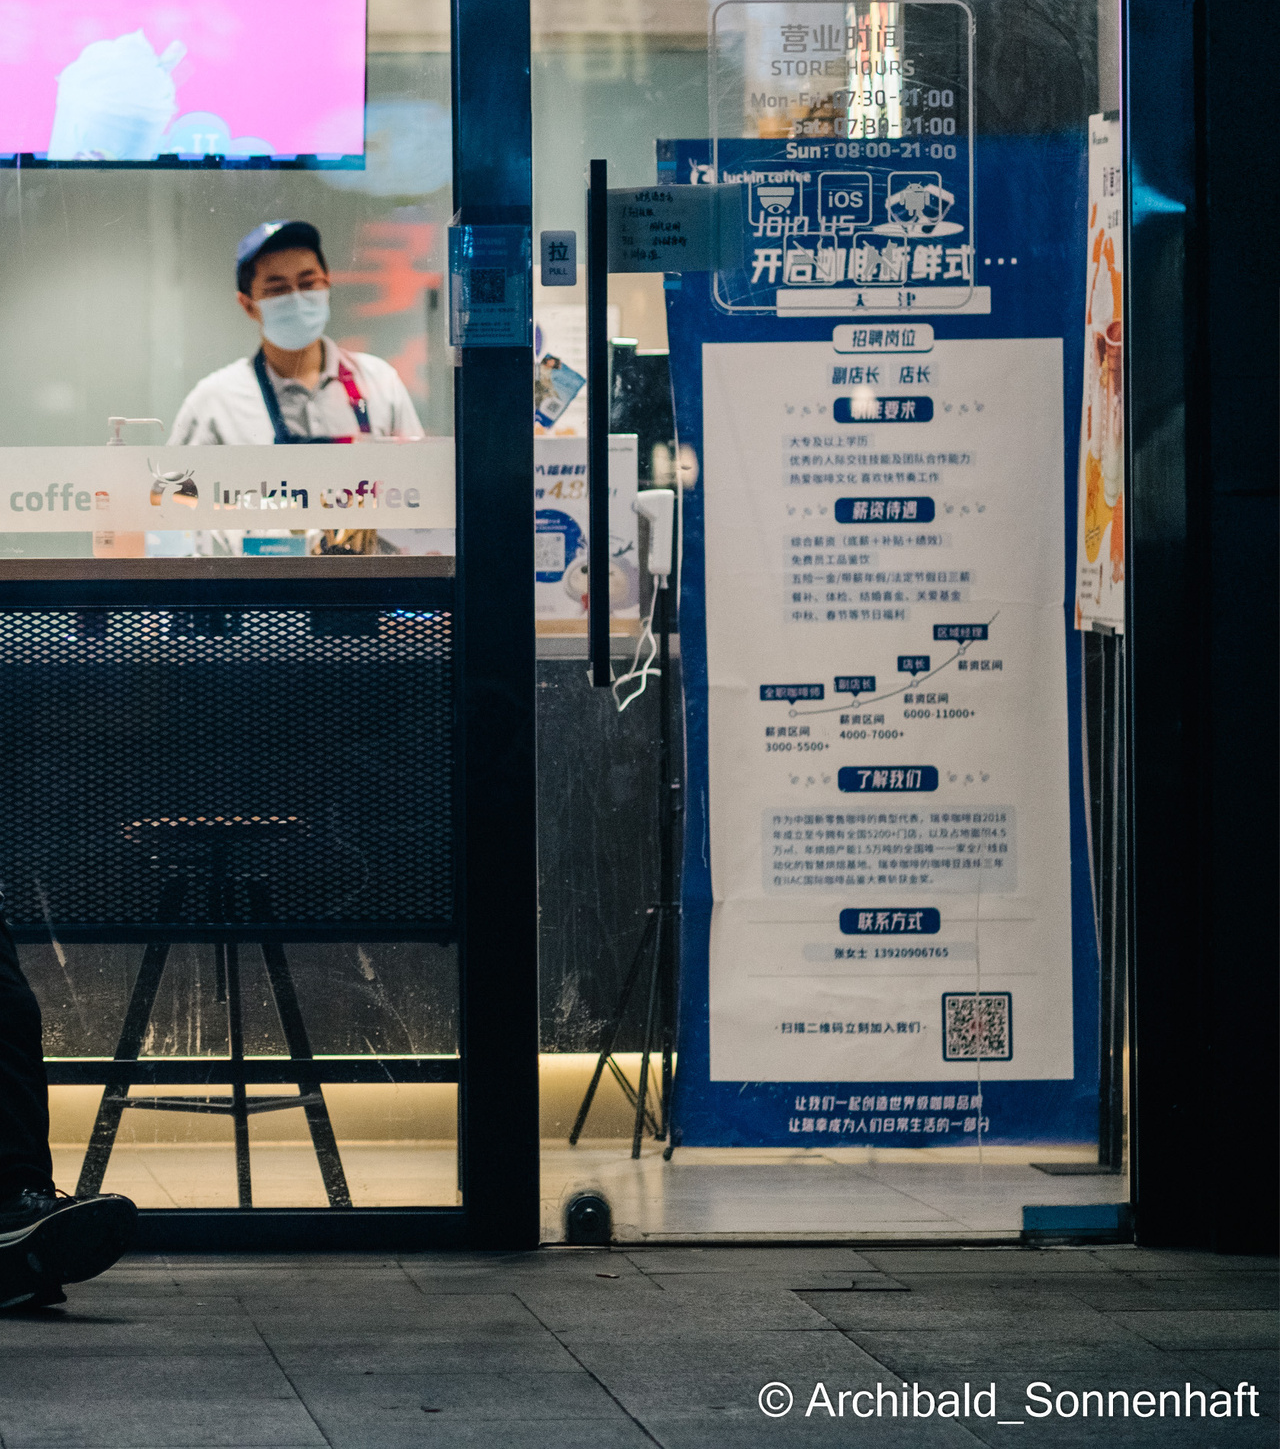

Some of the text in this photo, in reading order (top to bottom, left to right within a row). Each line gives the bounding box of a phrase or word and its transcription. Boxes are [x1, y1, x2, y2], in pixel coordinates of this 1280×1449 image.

[780, 24, 902, 53] 营业时间
[771, 59, 915, 76] STORE HOURS
[786, 142, 829, 159] Sun:
[723, 171, 811, 184] luckin coffee
[828, 191, 863, 208] iOS
[548, 241, 570, 262] 拉
[549, 267, 568, 276] PULL
[852, 329, 916, 347] 招聘岗位
[832, 366, 931, 385] 副店长 店长
[790, 436, 869, 448] 大专及以上学历
[213, 480, 421, 511] luckin coffee
[852, 501, 918, 520] 薪资待遇
[903, 659, 925, 670] 店长
[958, 660, 1003, 671] 薪资区间
[838, 679, 872, 691] 副店长
[904, 693, 949, 704] 薪资区间
[840, 714, 885, 725] 薪资区间
[904, 709, 976, 719] 6000-11000+
[765, 726, 810, 737] 薪资区间
[839, 729, 905, 740] 4000-7000+
[765, 742, 831, 753] 3000-5500+
[856, 770, 922, 789] 了解我们
[857, 912, 924, 932] 联系方式
[834, 947, 868, 959] 张女士
